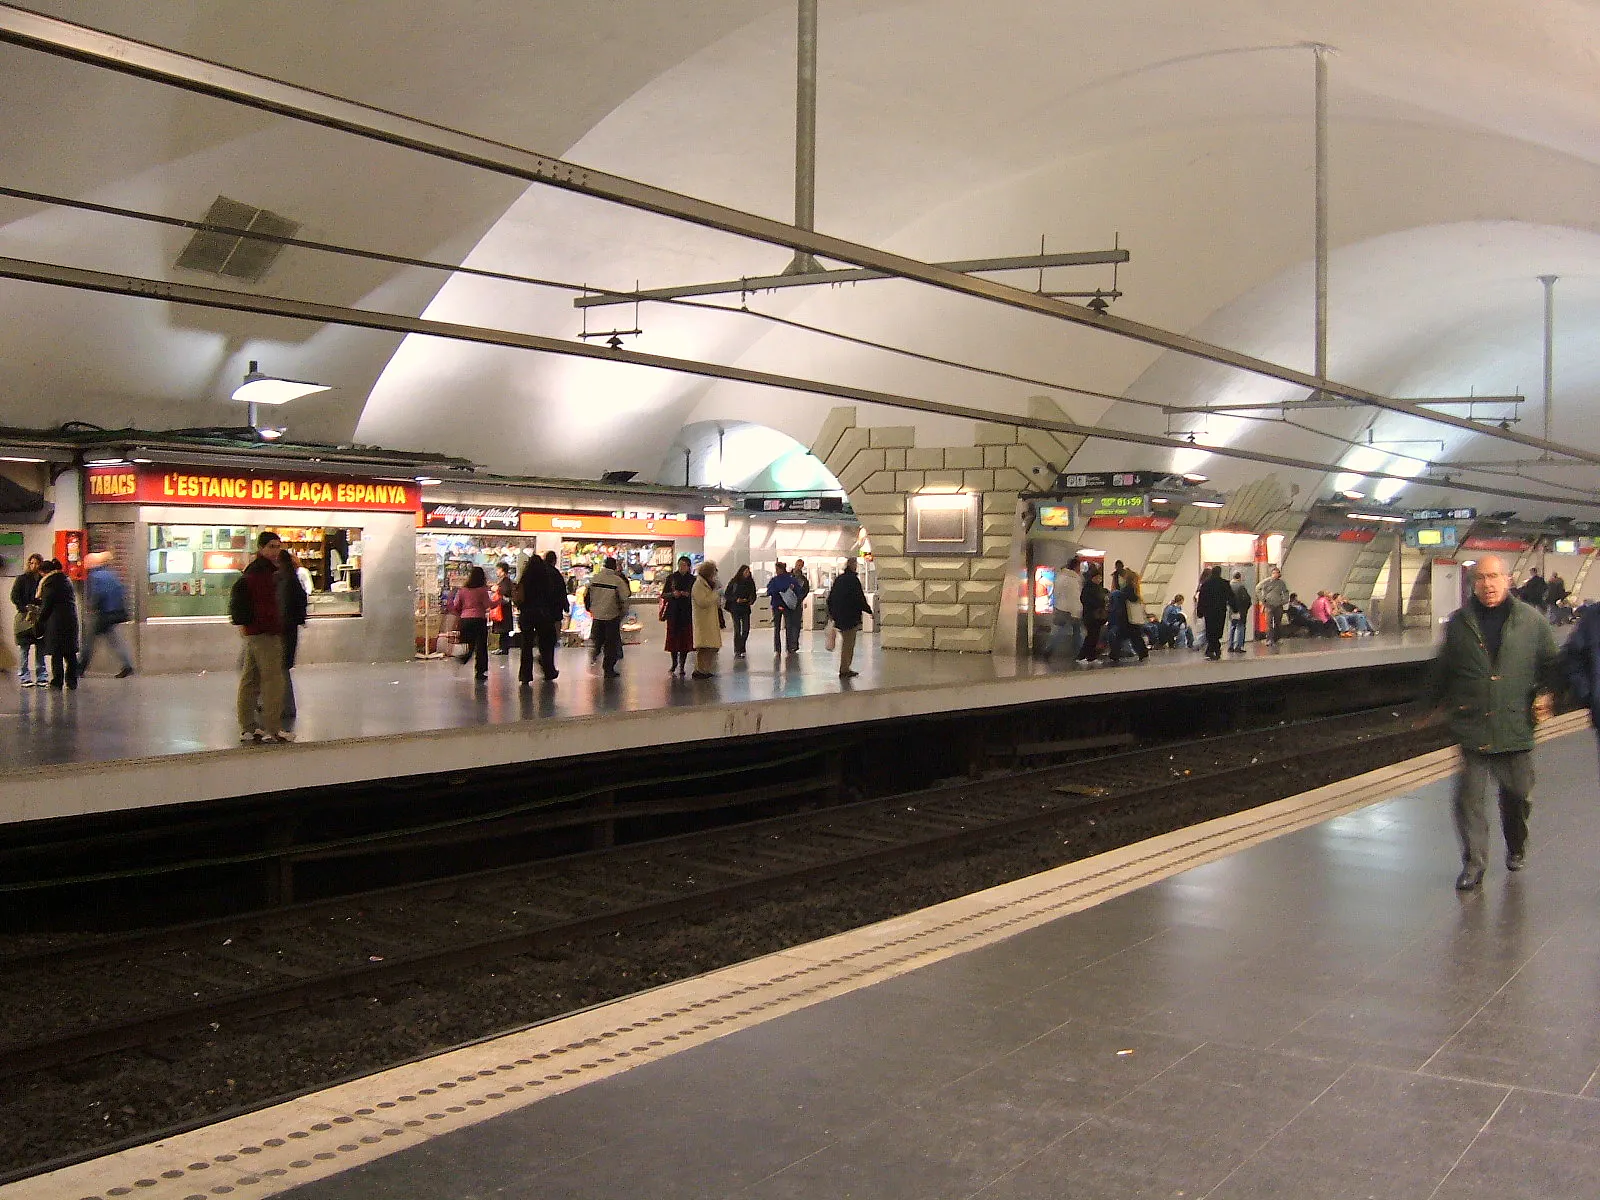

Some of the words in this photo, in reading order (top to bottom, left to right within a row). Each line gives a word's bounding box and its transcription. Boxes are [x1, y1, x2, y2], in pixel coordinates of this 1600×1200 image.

[89, 474, 136, 496] TABACS
[164, 472, 247, 499] L'ESTANC
[251, 479, 275, 500] DE
[278, 481, 332, 505] PLAÇA
[337, 484, 407, 505] ESPANYA
